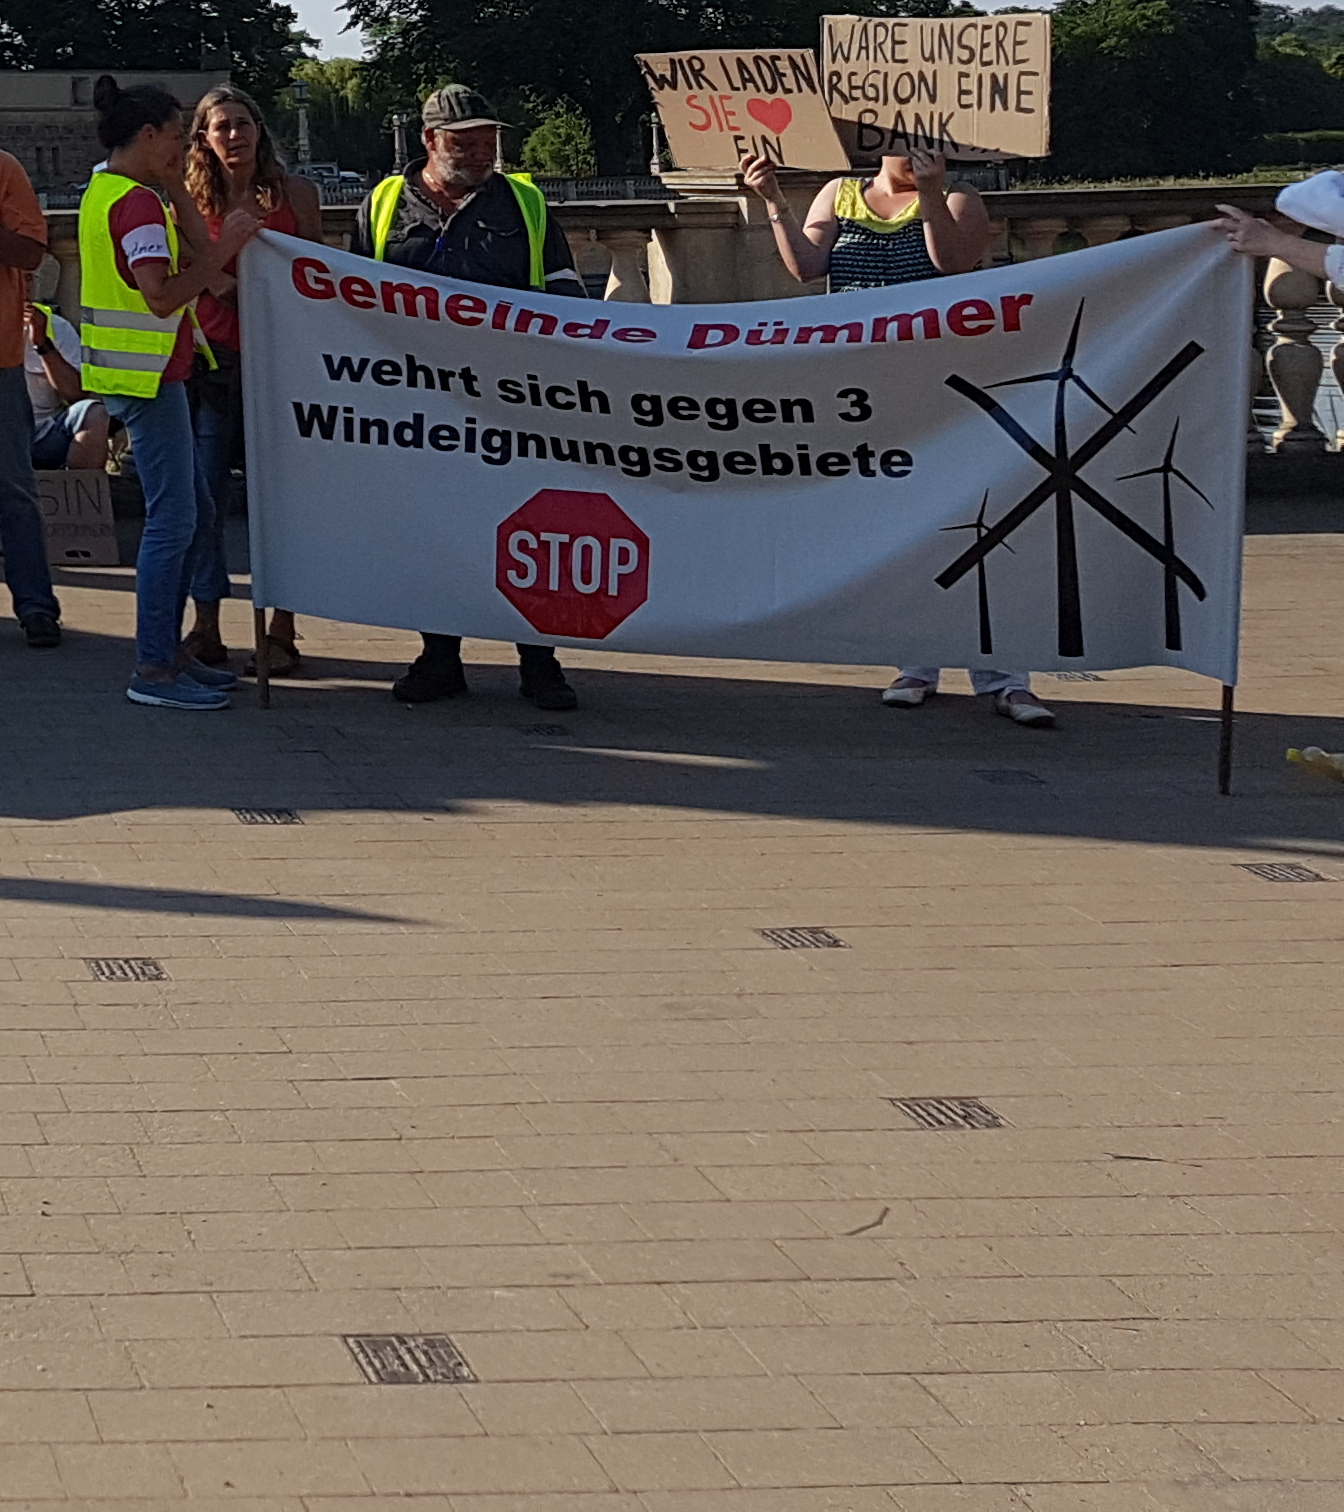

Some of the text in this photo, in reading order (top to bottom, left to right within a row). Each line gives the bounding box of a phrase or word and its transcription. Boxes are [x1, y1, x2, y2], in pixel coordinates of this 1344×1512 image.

[828, 16, 1033, 67] WÄRE UNSERE
[643, 54, 819, 96] WIR LADEN
[827, 70, 1040, 114] REGION EINE
[685, 93, 741, 134] SIE
[733, 134, 784, 166] EIN
[291, 257, 1034, 350] Gemeinde Dümmer
[321, 353, 873, 431] wehrt sich gegen 3
[292, 401, 914, 483] Windeignungsgebiete
[507, 530, 639, 597] STOP
